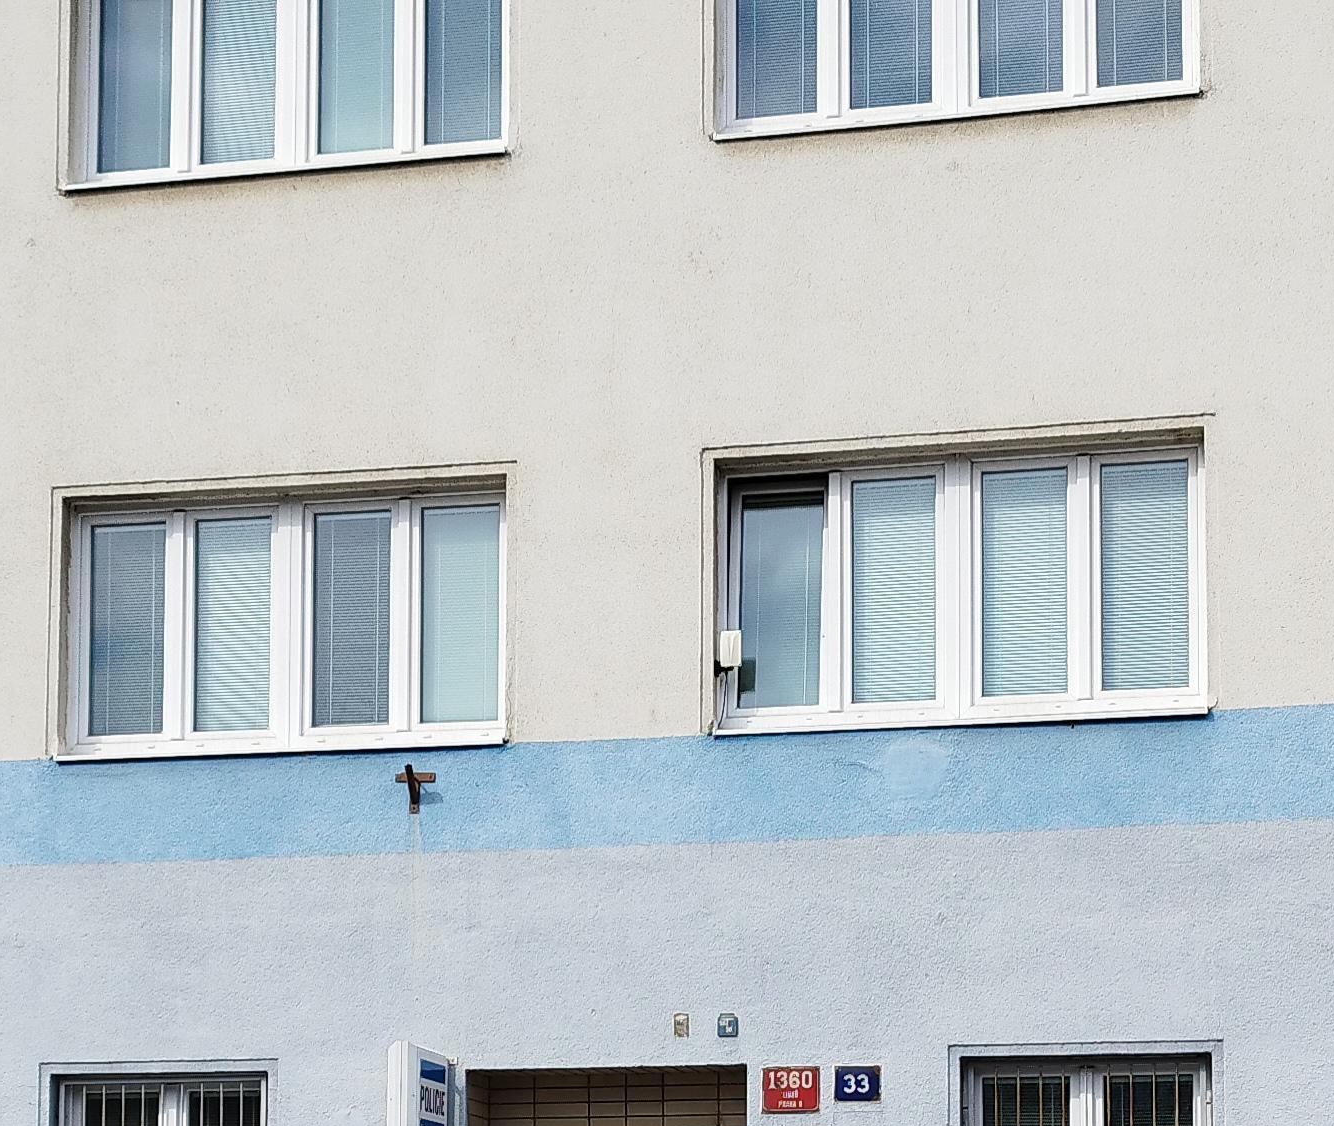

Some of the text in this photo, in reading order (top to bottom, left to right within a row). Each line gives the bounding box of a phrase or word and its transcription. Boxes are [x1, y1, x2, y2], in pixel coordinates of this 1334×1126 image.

[768, 1070, 813, 1089] 1360
[843, 1073, 870, 1094] 33
[419, 1085, 445, 1117] POLICIE
